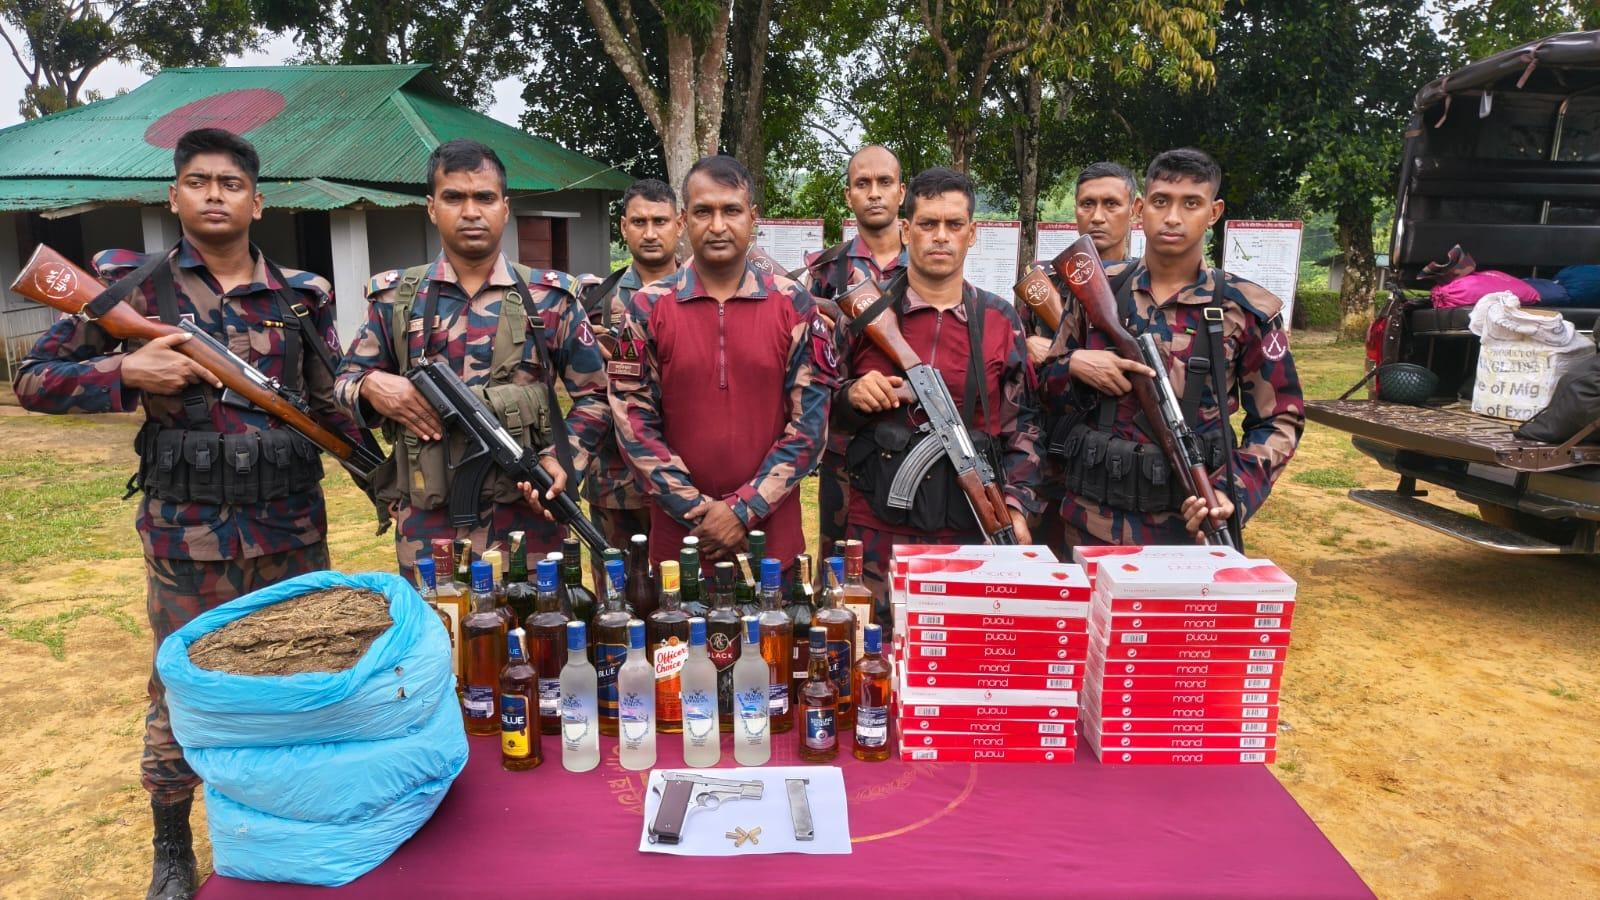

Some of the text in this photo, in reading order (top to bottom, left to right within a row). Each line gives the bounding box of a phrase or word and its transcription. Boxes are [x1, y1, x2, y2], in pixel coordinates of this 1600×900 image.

[1490, 381, 1505, 395] of
[1510, 382, 1540, 399] Mfg
[1487, 404, 1500, 416] of
[985, 584, 1017, 595] mond
[1184, 603, 1217, 613] mond
[982, 616, 1014, 626] mond
[1184, 618, 1216, 628] mond
[985, 632, 1017, 642] mond
[1185, 632, 1218, 642] mond
[706, 652, 733, 660] BLACK
[984, 647, 1016, 657] mond
[1178, 649, 1211, 659] mond
[655, 661, 682, 674] Choice
[979, 663, 1010, 673] mond
[1176, 664, 1209, 674] mond
[597, 667, 616, 679] BLUE
[977, 678, 1009, 688] mond
[1174, 679, 1207, 689] mond
[1172, 693, 1204, 704] mond
[976, 706, 1008, 716] mond
[1172, 708, 1205, 718] mond
[501, 714, 526, 726] BLUE
[970, 722, 1001, 732] mond
[1172, 723, 1204, 733] mond
[973, 737, 1004, 747] mond
[1171, 738, 1203, 748] mond
[974, 750, 1005, 760] mond
[1172, 753, 1204, 763] mond
